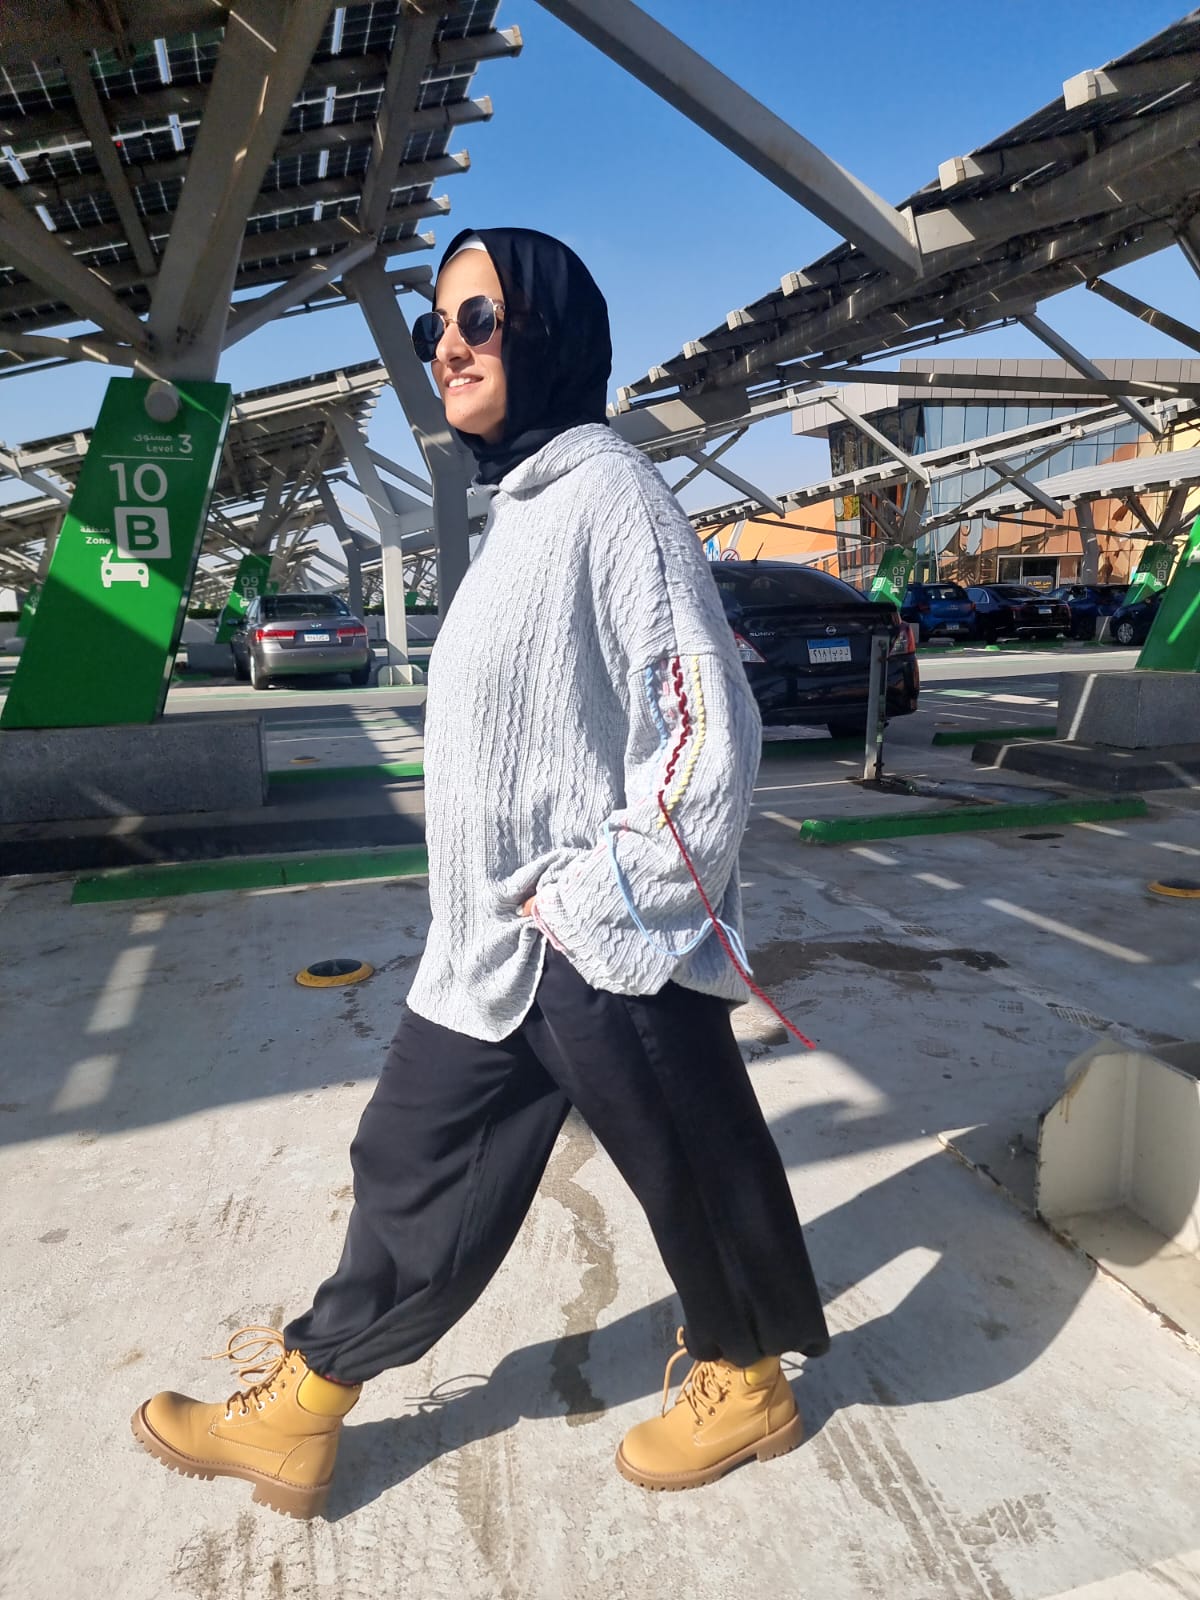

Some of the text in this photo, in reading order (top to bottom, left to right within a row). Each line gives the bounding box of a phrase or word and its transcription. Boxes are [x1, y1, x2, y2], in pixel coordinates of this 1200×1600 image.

[146, 433, 193, 454] Level 3
[108, 462, 168, 503] 10
[125, 514, 160, 551] B
[85, 536, 112, 545] Zone
[1156, 560, 1168, 570] 09
[892, 566, 906, 576] 09
[240, 576, 259, 587] 09
